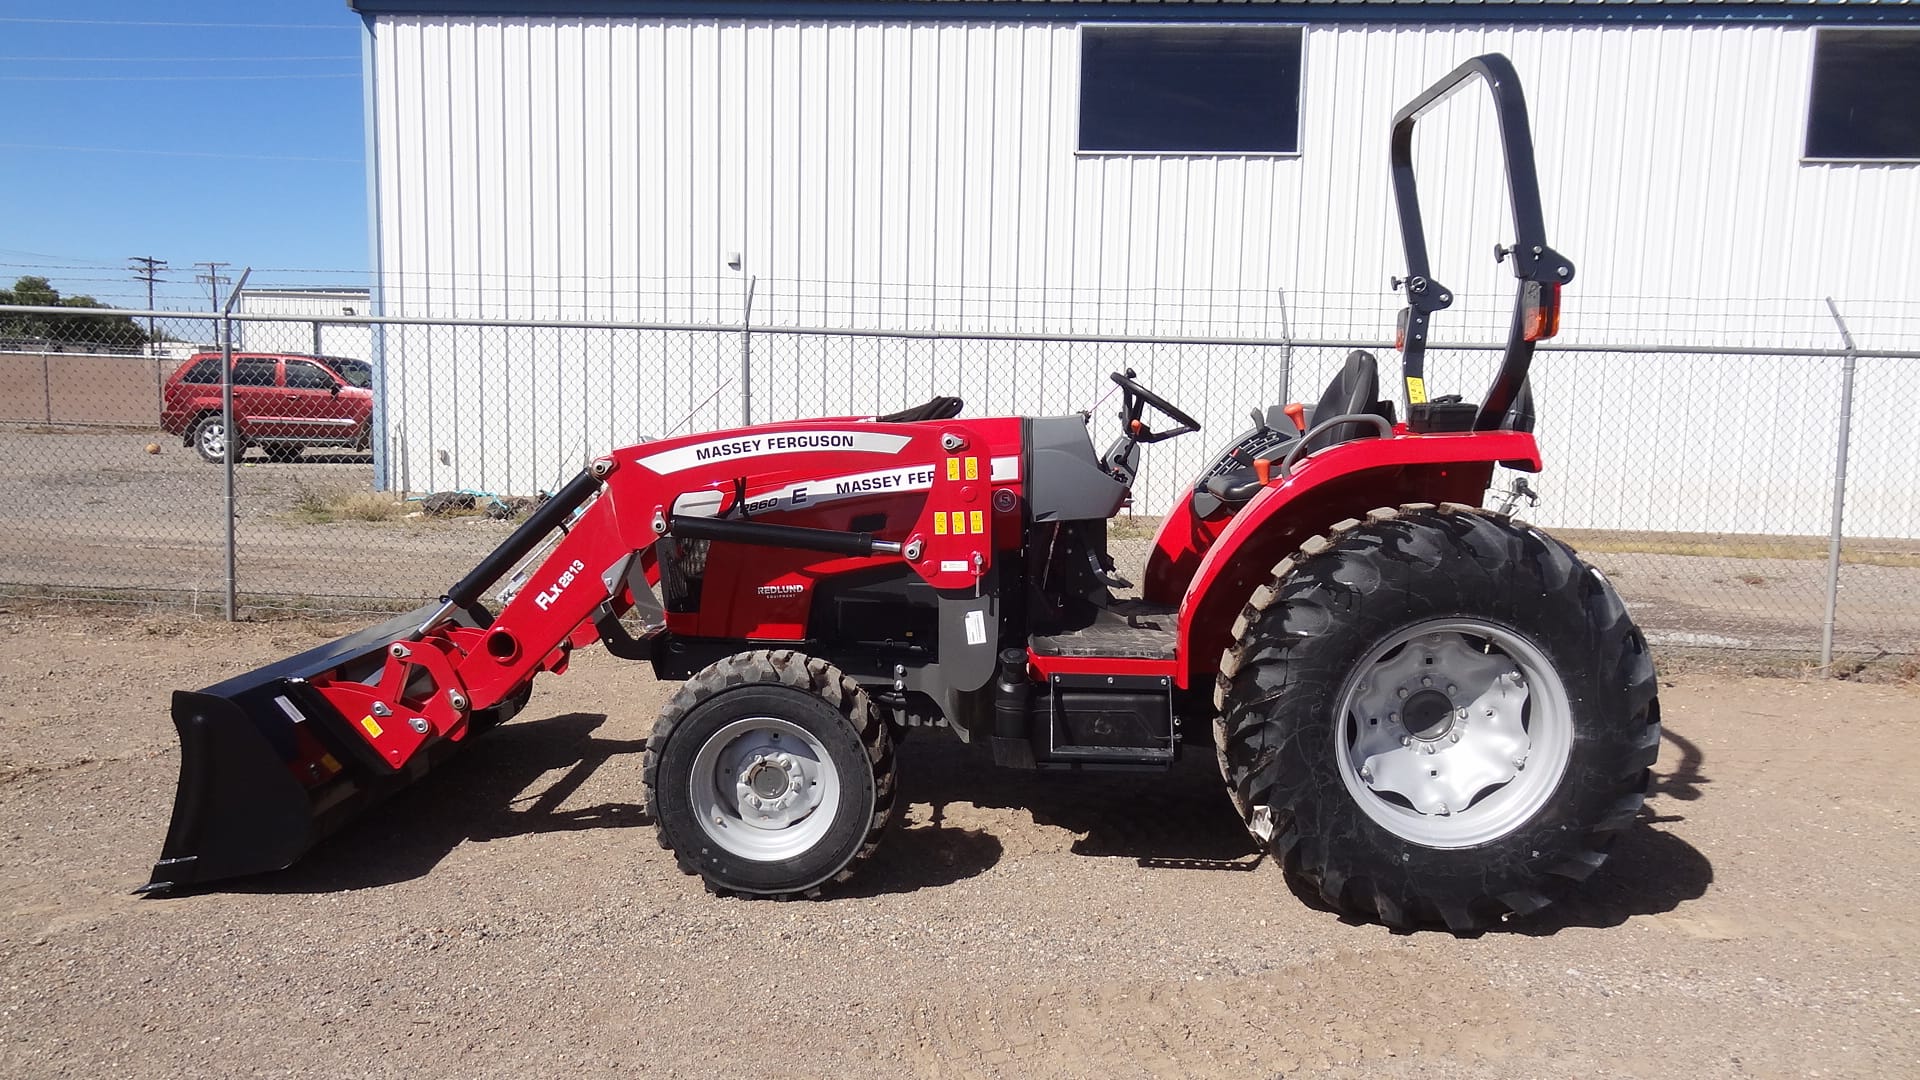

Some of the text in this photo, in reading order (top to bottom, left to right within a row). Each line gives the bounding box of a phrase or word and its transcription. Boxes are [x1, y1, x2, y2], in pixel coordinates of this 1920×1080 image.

[696, 435, 854, 460] MASSEY FERGUSON
[836, 475, 901, 495] MASSEY
[792, 488, 808, 504] E
[558, 560, 585, 588] 2813
[757, 585, 804, 595] REDLUND
